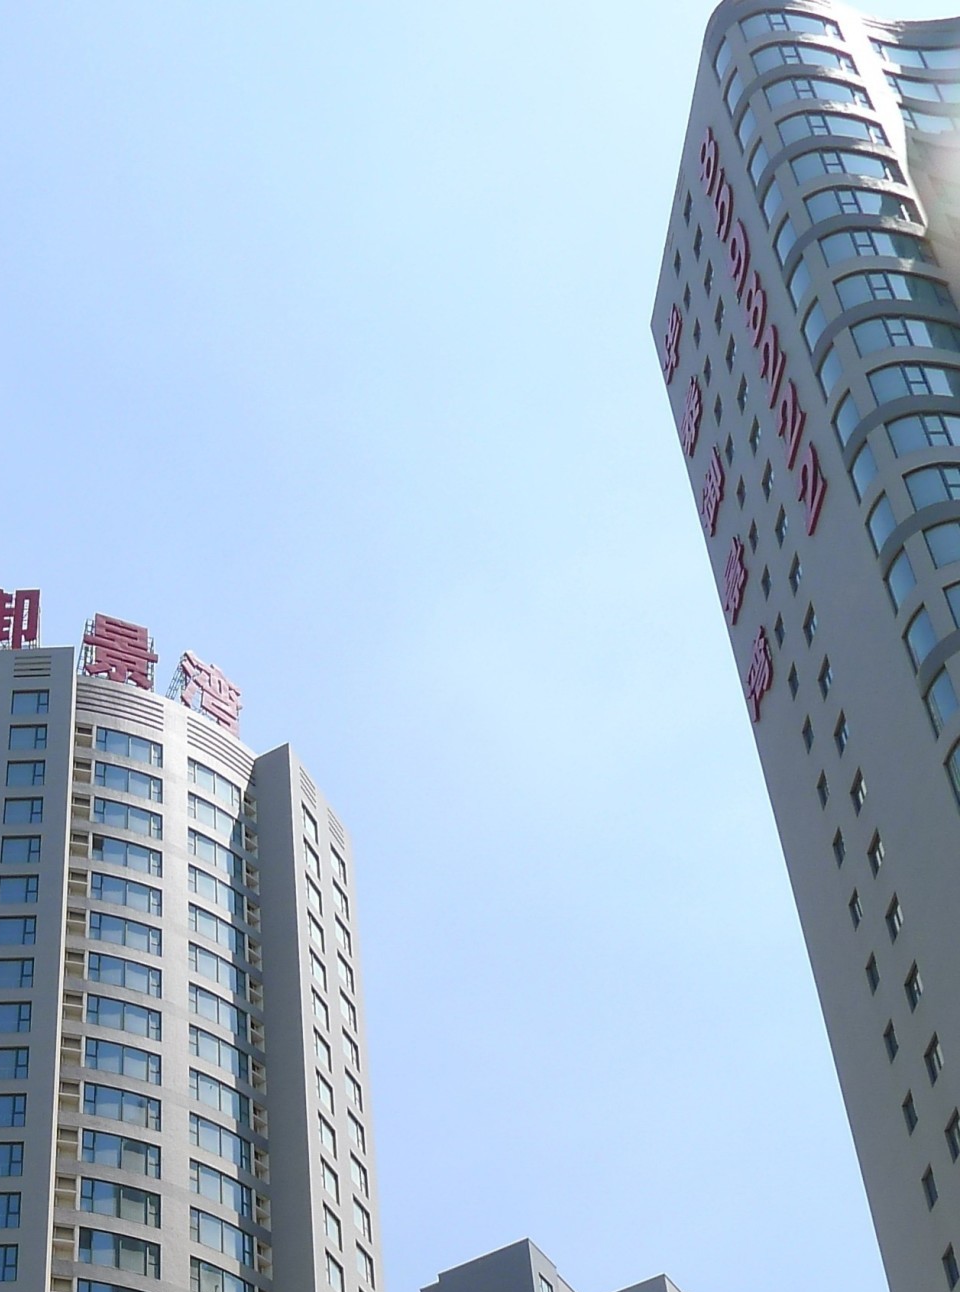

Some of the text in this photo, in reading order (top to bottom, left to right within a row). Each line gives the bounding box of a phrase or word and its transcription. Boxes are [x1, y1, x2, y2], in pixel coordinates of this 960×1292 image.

[664, 303, 773, 722] 华泰御景湾
[700, 127, 827, 536] 8598222
